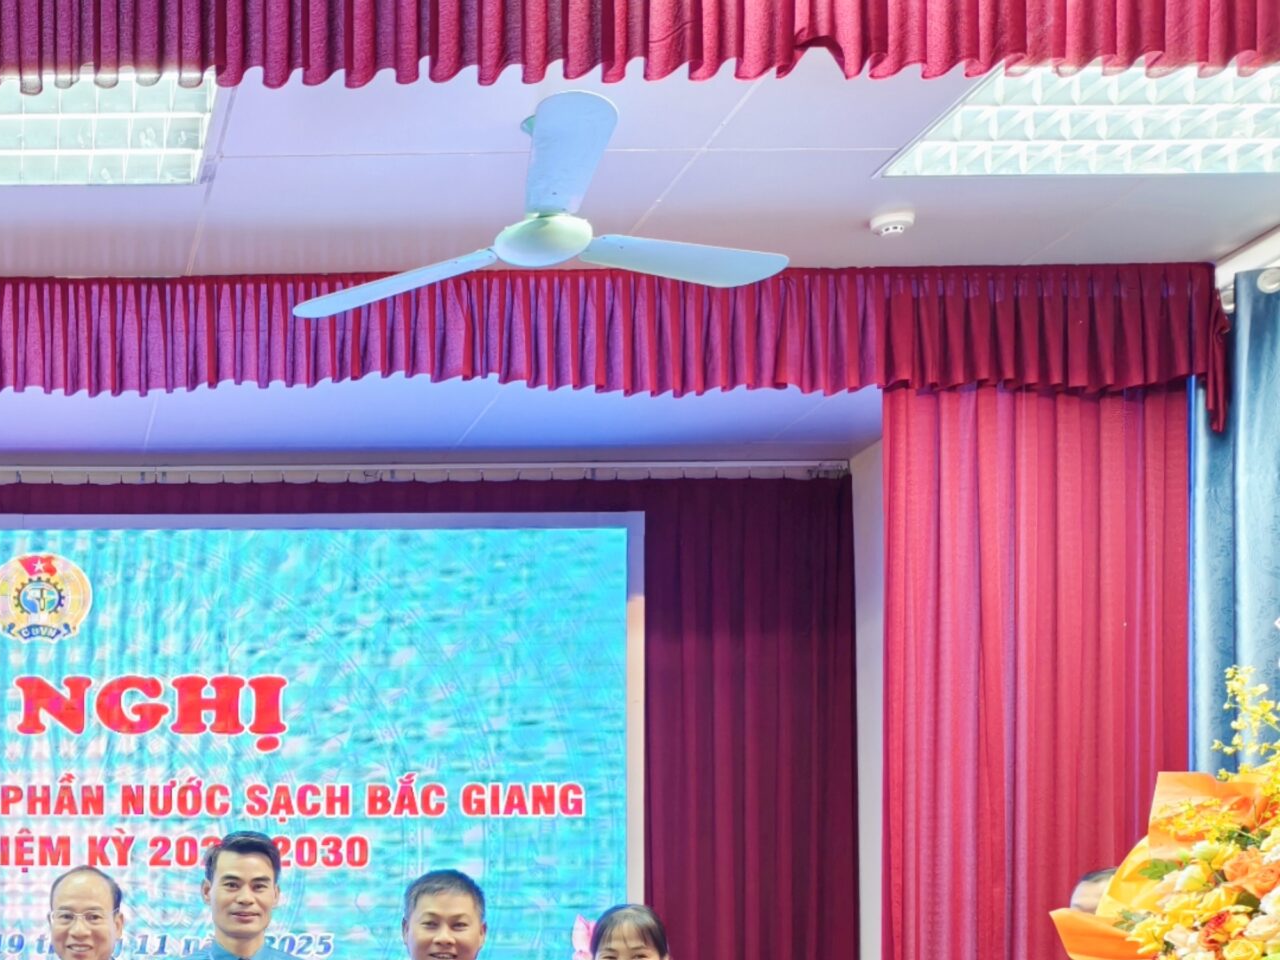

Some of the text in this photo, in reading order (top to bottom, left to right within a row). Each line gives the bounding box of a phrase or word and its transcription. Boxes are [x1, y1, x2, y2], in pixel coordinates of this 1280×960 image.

[14, 675, 288, 752] NGHỊ
[0, 772, 105, 816] PHẦN
[120, 776, 231, 817] NƯỚC
[245, 784, 351, 824] SẠCH
[366, 772, 447, 816] BẮC
[461, 783, 584, 816] GIANG
[87, 828, 136, 867] KỲ
[135, 934, 168, 955] 11
